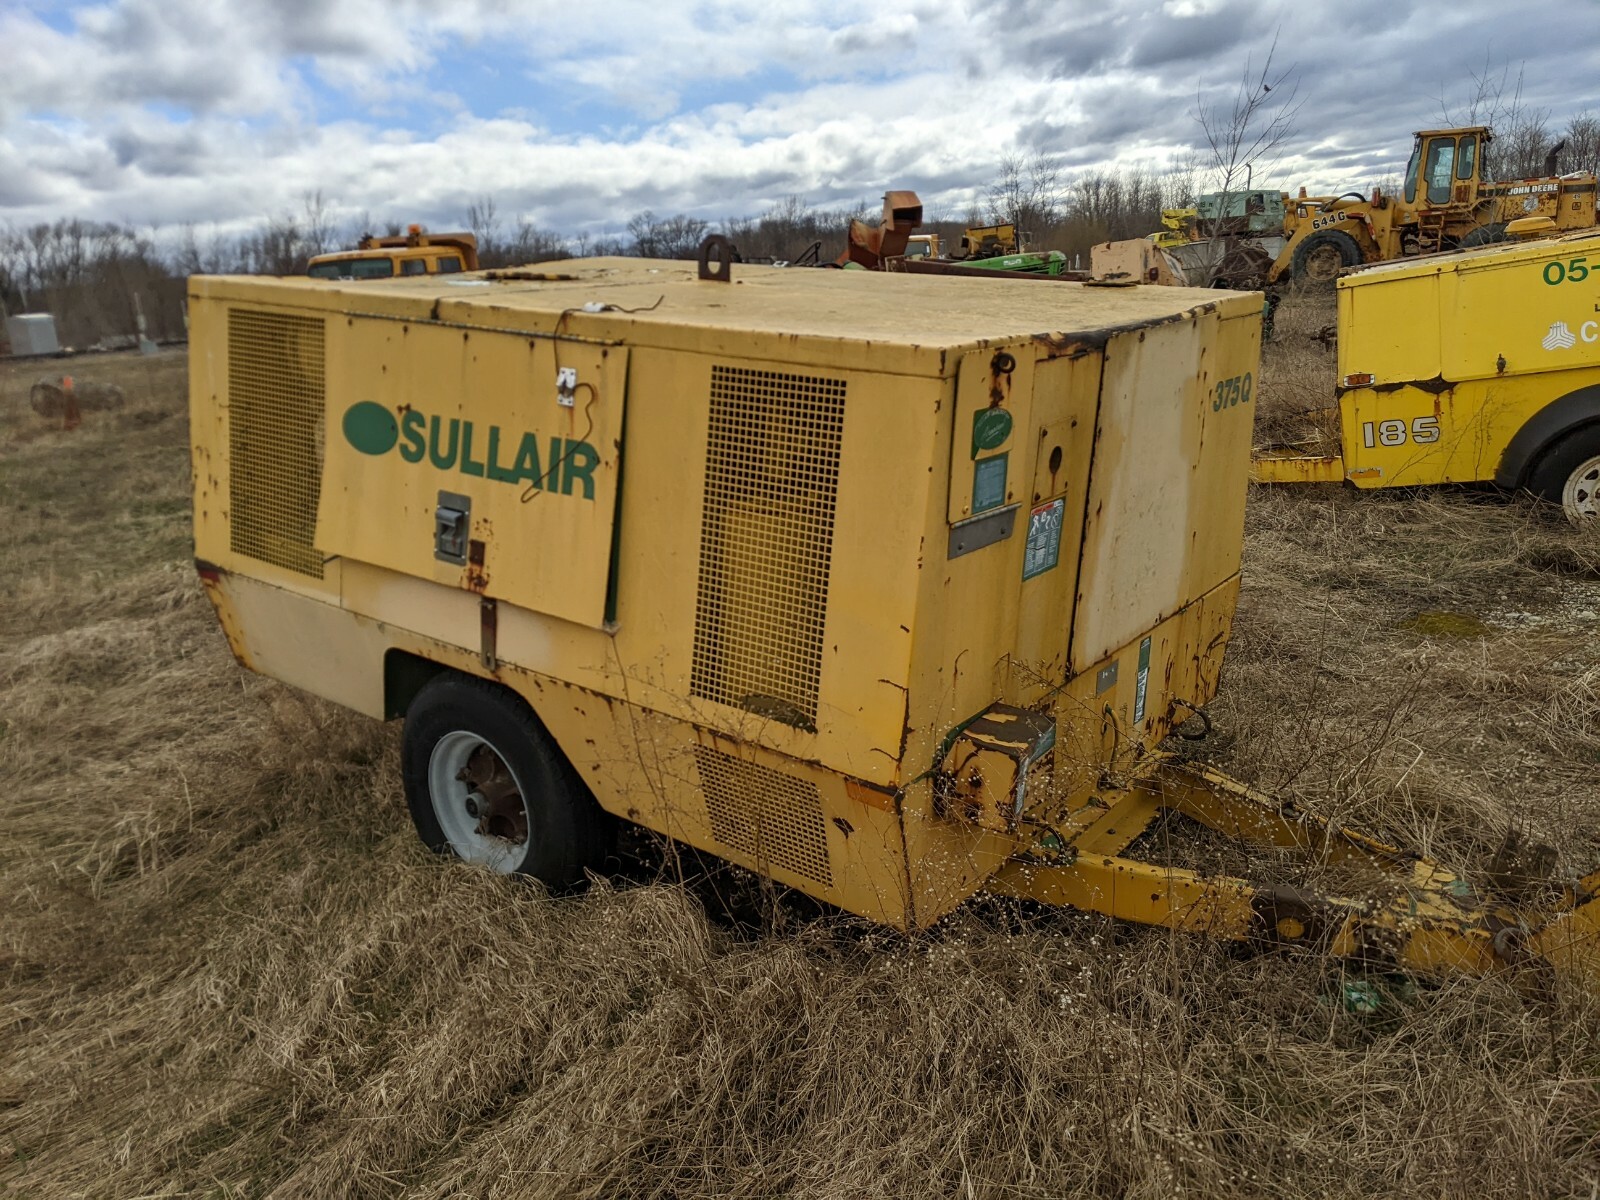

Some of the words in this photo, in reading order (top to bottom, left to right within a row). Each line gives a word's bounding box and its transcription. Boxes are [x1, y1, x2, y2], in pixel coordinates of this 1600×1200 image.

[1508, 186, 1530, 195] JOHN
[1531, 183, 1559, 193] DEERE
[1312, 211, 1346, 230] 644G
[1213, 371, 1252, 412] 375Q
[1363, 416, 1440, 448] 185
[400, 409, 600, 501] SULLAIR
